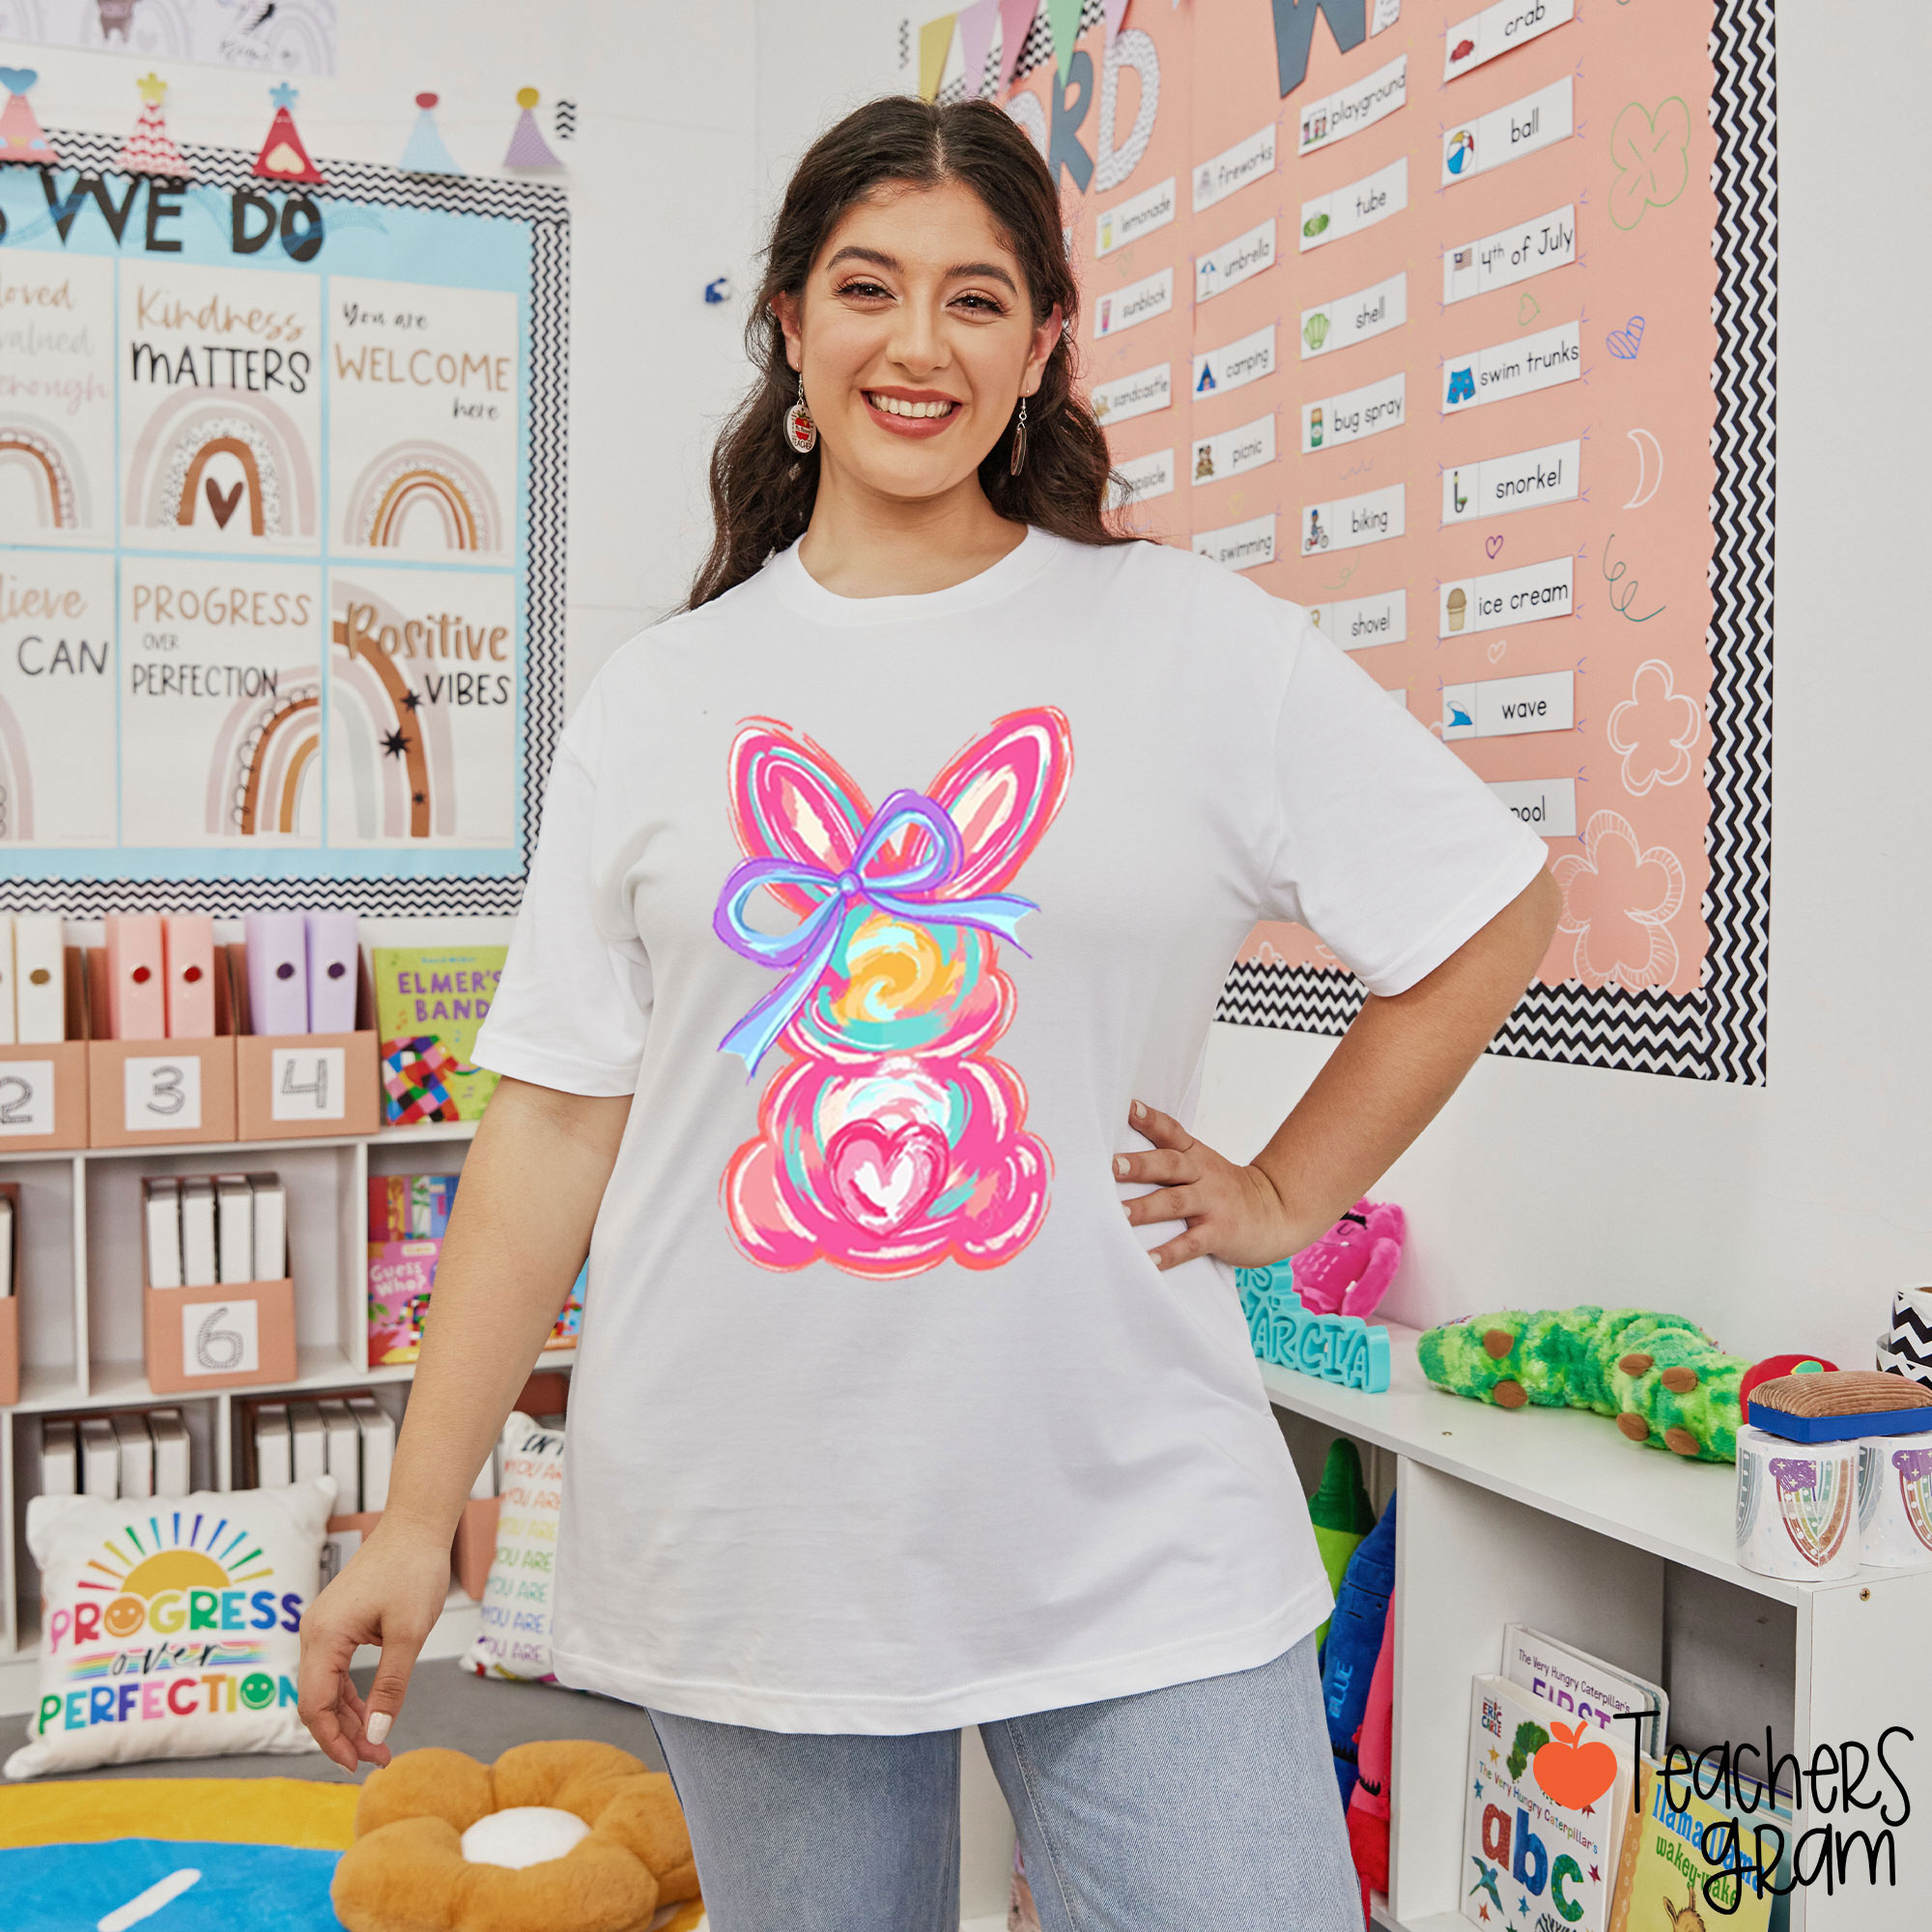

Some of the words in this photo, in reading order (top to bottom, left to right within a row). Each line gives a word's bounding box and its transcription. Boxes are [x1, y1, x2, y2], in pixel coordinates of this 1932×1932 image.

[1505, 0, 1546, 37] crab
[1330, 64, 1406, 131] playground
[1511, 107, 1540, 144] ball
[1218, 142, 1273, 186] fireworks
[39, 168, 186, 253] WE
[232, 191, 325, 263] DO
[1122, 193, 1171, 233] lemonade
[1355, 188, 1387, 217] tube
[1225, 238, 1270, 278] umbrella
[1511, 236, 1531, 266] of
[1538, 223, 1574, 255] July
[137, 286, 305, 343] Kindness
[343, 302, 384, 327] You
[394, 313, 428, 330] are
[1122, 282, 1167, 319] sunblock
[1355, 296, 1385, 329] shell
[335, 343, 511, 392] WELCOME
[1226, 349, 1268, 380] camping
[1480, 362, 1520, 385] swim
[1526, 340, 1579, 374] trunks
[453, 398, 499, 420] here
[1114, 373, 1170, 409] sandcastle
[1334, 410, 1360, 433] bug
[1364, 396, 1403, 426] spray
[1233, 440, 1263, 469] picnic
[1495, 459, 1562, 498] snorkel
[1351, 509, 1388, 533] biking
[1220, 536, 1272, 563] swimming
[132, 584, 311, 626] PROGRESS
[1479, 596, 1503, 616] ice
[1510, 584, 1569, 610] cream
[346, 602, 509, 661] Positive
[1351, 607, 1391, 636] shovel
[18, 636, 107, 675] CAN
[144, 634, 179, 651] OVER
[132, 664, 278, 696] PERFECTION
[425, 672, 510, 705] VIBES
[1501, 700, 1548, 719] wave
[414, 999, 491, 1022] BAND
[0, 1076, 33, 1124] 2
[148, 1065, 185, 1116] 3
[282, 1059, 327, 1109] 4
[370, 1262, 423, 1283] Guess
[374, 1273, 427, 1297] Who?
[197, 1307, 242, 1370] 6
[112, 1641, 250, 1676] over
[1328, 1661, 1353, 1719] BLUE
[1519, 1648, 1531, 1665] The
[1533, 1656, 1549, 1677] Very
[1551, 1665, 1579, 1692] Hungry
[1580, 1681, 1631, 1714] Caterpillar's
[1481, 1715, 1502, 1740] CARLE
[1483, 1701, 1503, 1725] ERIC
[1479, 1761, 1492, 1779] The
[1494, 1772, 1512, 1797] Very
[1513, 1786, 1543, 1819] Hungry
[1544, 1808, 1599, 1855] Caterpillar's
[1482, 1804, 1584, 1922] abc
